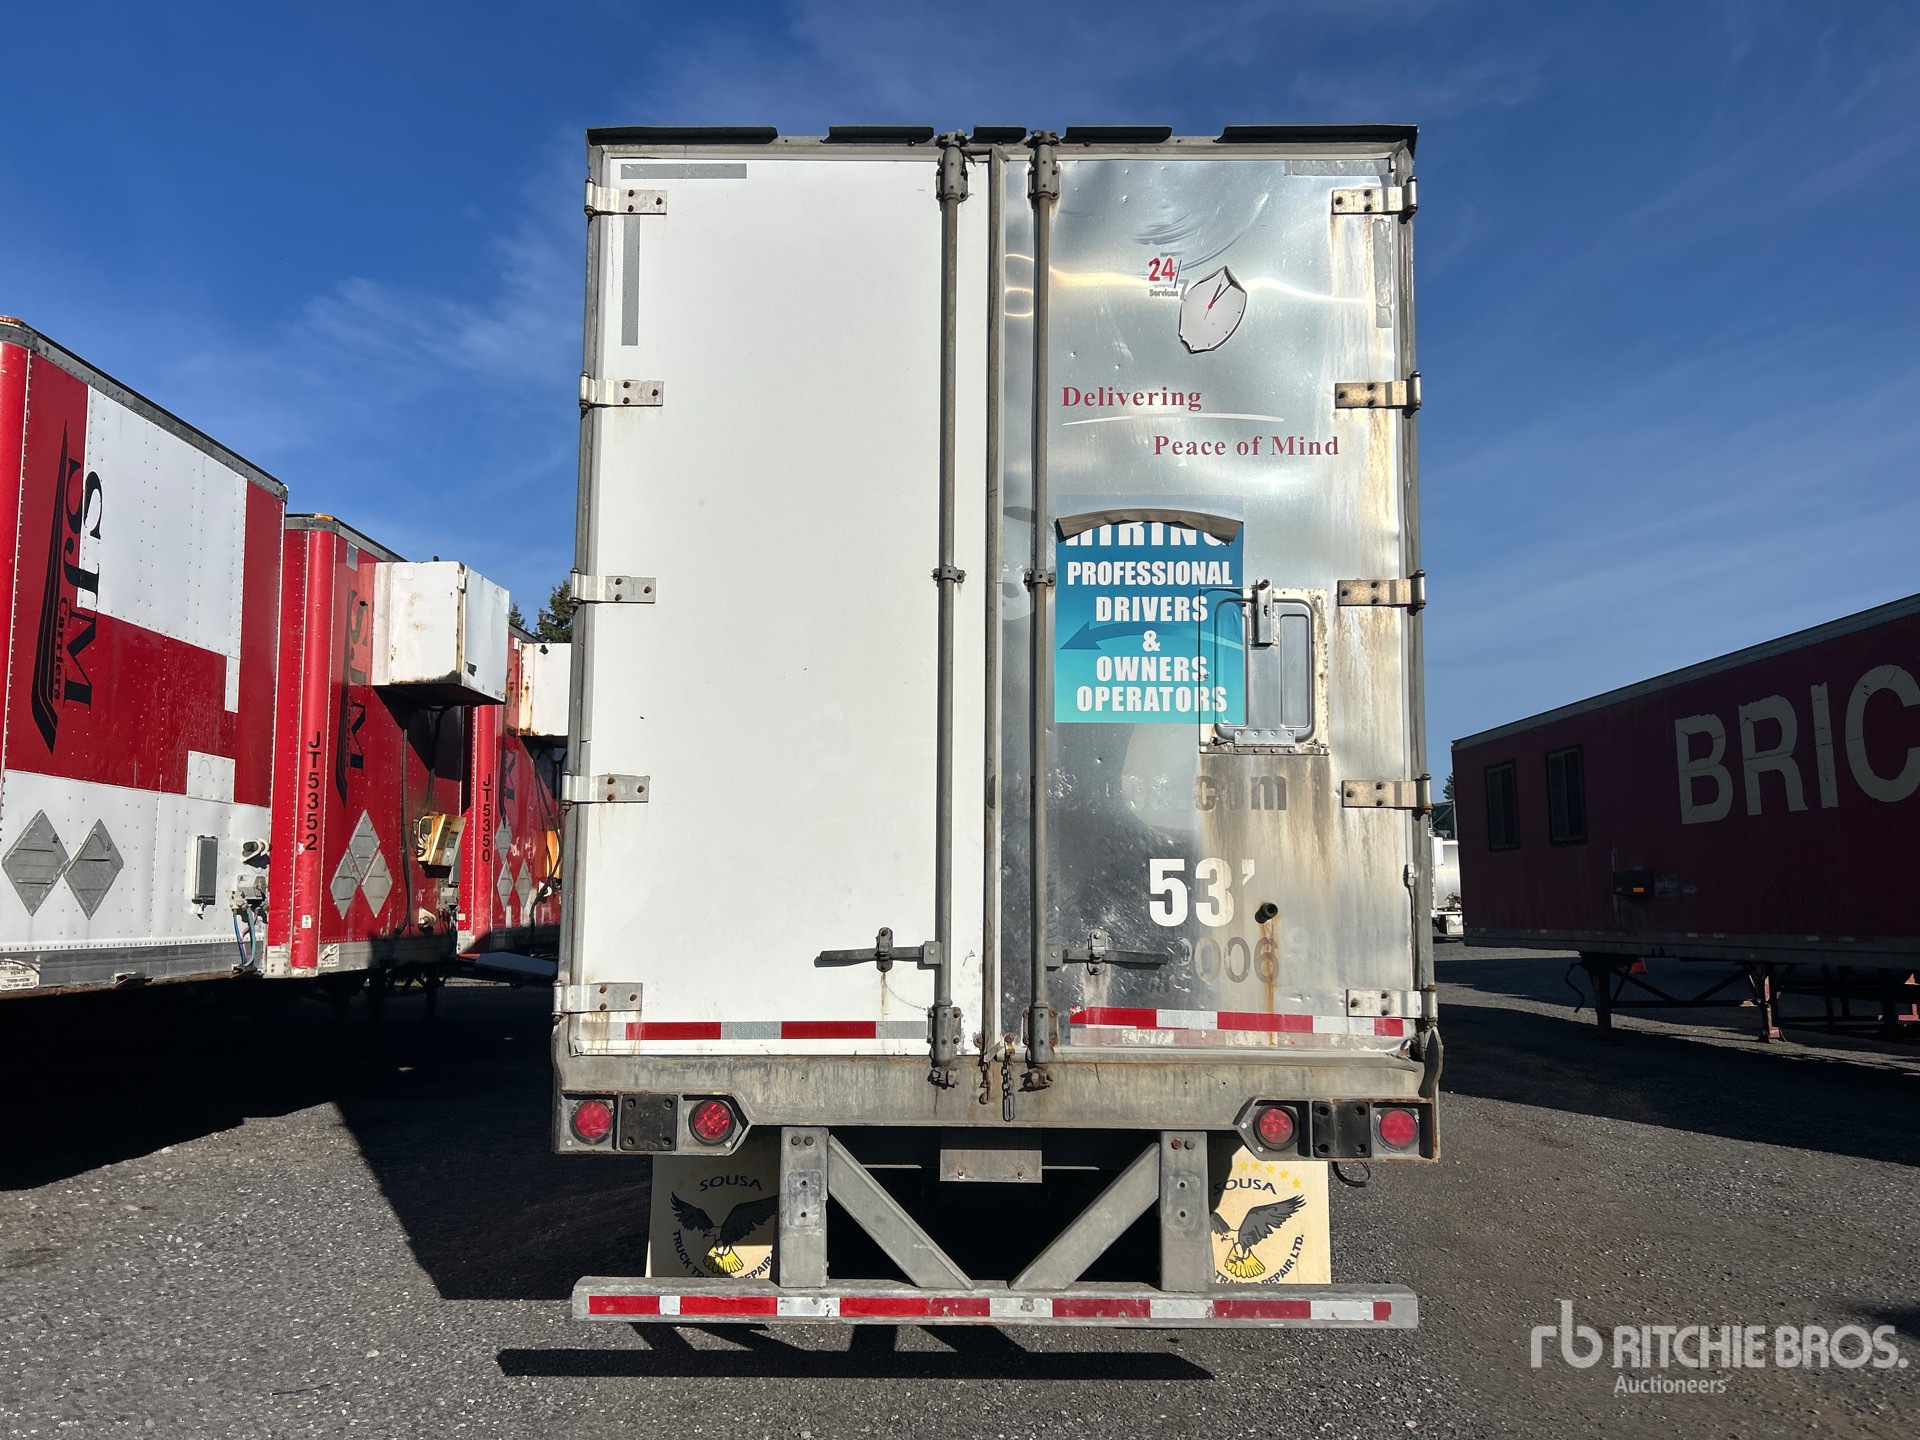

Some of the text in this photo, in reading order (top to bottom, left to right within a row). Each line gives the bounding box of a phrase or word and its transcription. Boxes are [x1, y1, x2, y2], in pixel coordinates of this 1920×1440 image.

[1061, 386, 1202, 411] Delivering
[1153, 435, 1340, 456] Peace of Mind
[1067, 560, 1233, 586] PROFESSIONAL
[1095, 595, 1208, 622] DRIVERS
[1142, 630, 1161, 652] &
[1096, 656, 1209, 682] OWNERS
[1076, 686, 1228, 713] OPERATORS
[305, 731, 321, 851] JT5352
[481, 774, 491, 862] JT5350
[1149, 857, 1255, 927] 53'
[699, 1175, 762, 1192] SOUSA
[1213, 1178, 1277, 1195] SOUSA
[672, 1229, 694, 1270] TRUCK
[1289, 1234, 1305, 1259] LTD.
